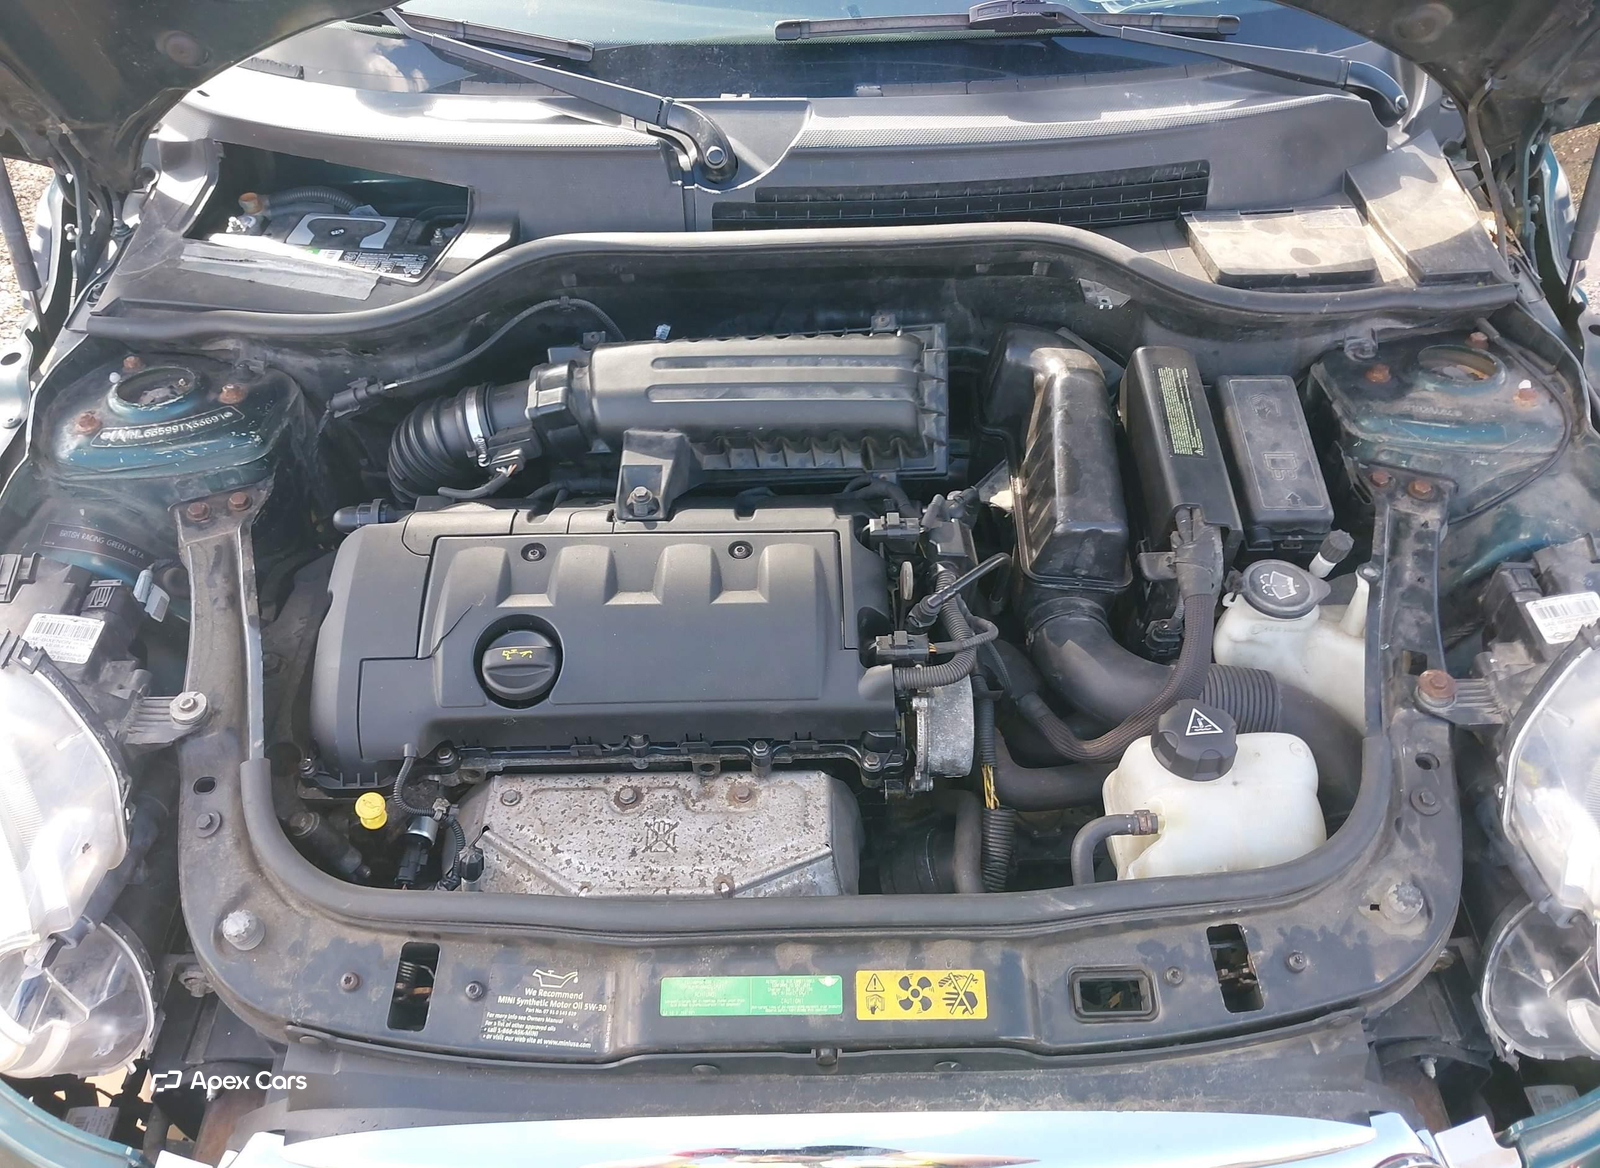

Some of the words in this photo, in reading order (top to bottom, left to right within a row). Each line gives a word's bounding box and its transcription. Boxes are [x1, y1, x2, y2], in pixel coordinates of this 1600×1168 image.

[59, 529, 80, 539] BRITISH
[81, 532, 105, 544] RACING
[106, 539, 127, 551] GREEN
[128, 547, 144, 559] META
[525, 987, 537, 996] We
[538, 988, 584, 1000] Recommend
[498, 995, 516, 1004] MINI
[516, 996, 549, 1007] Synthetic
[549, 999, 571, 1009] Motor
[572, 1001, 584, 1010] Oil
[584, 1002, 607, 1012] 5W-30
[507, 1013, 518, 1021] info
[545, 1016, 564, 1024] Manual
[492, 1033, 504, 1041] visit
[543, 1039, 592, 1049] www.miniusa.com
